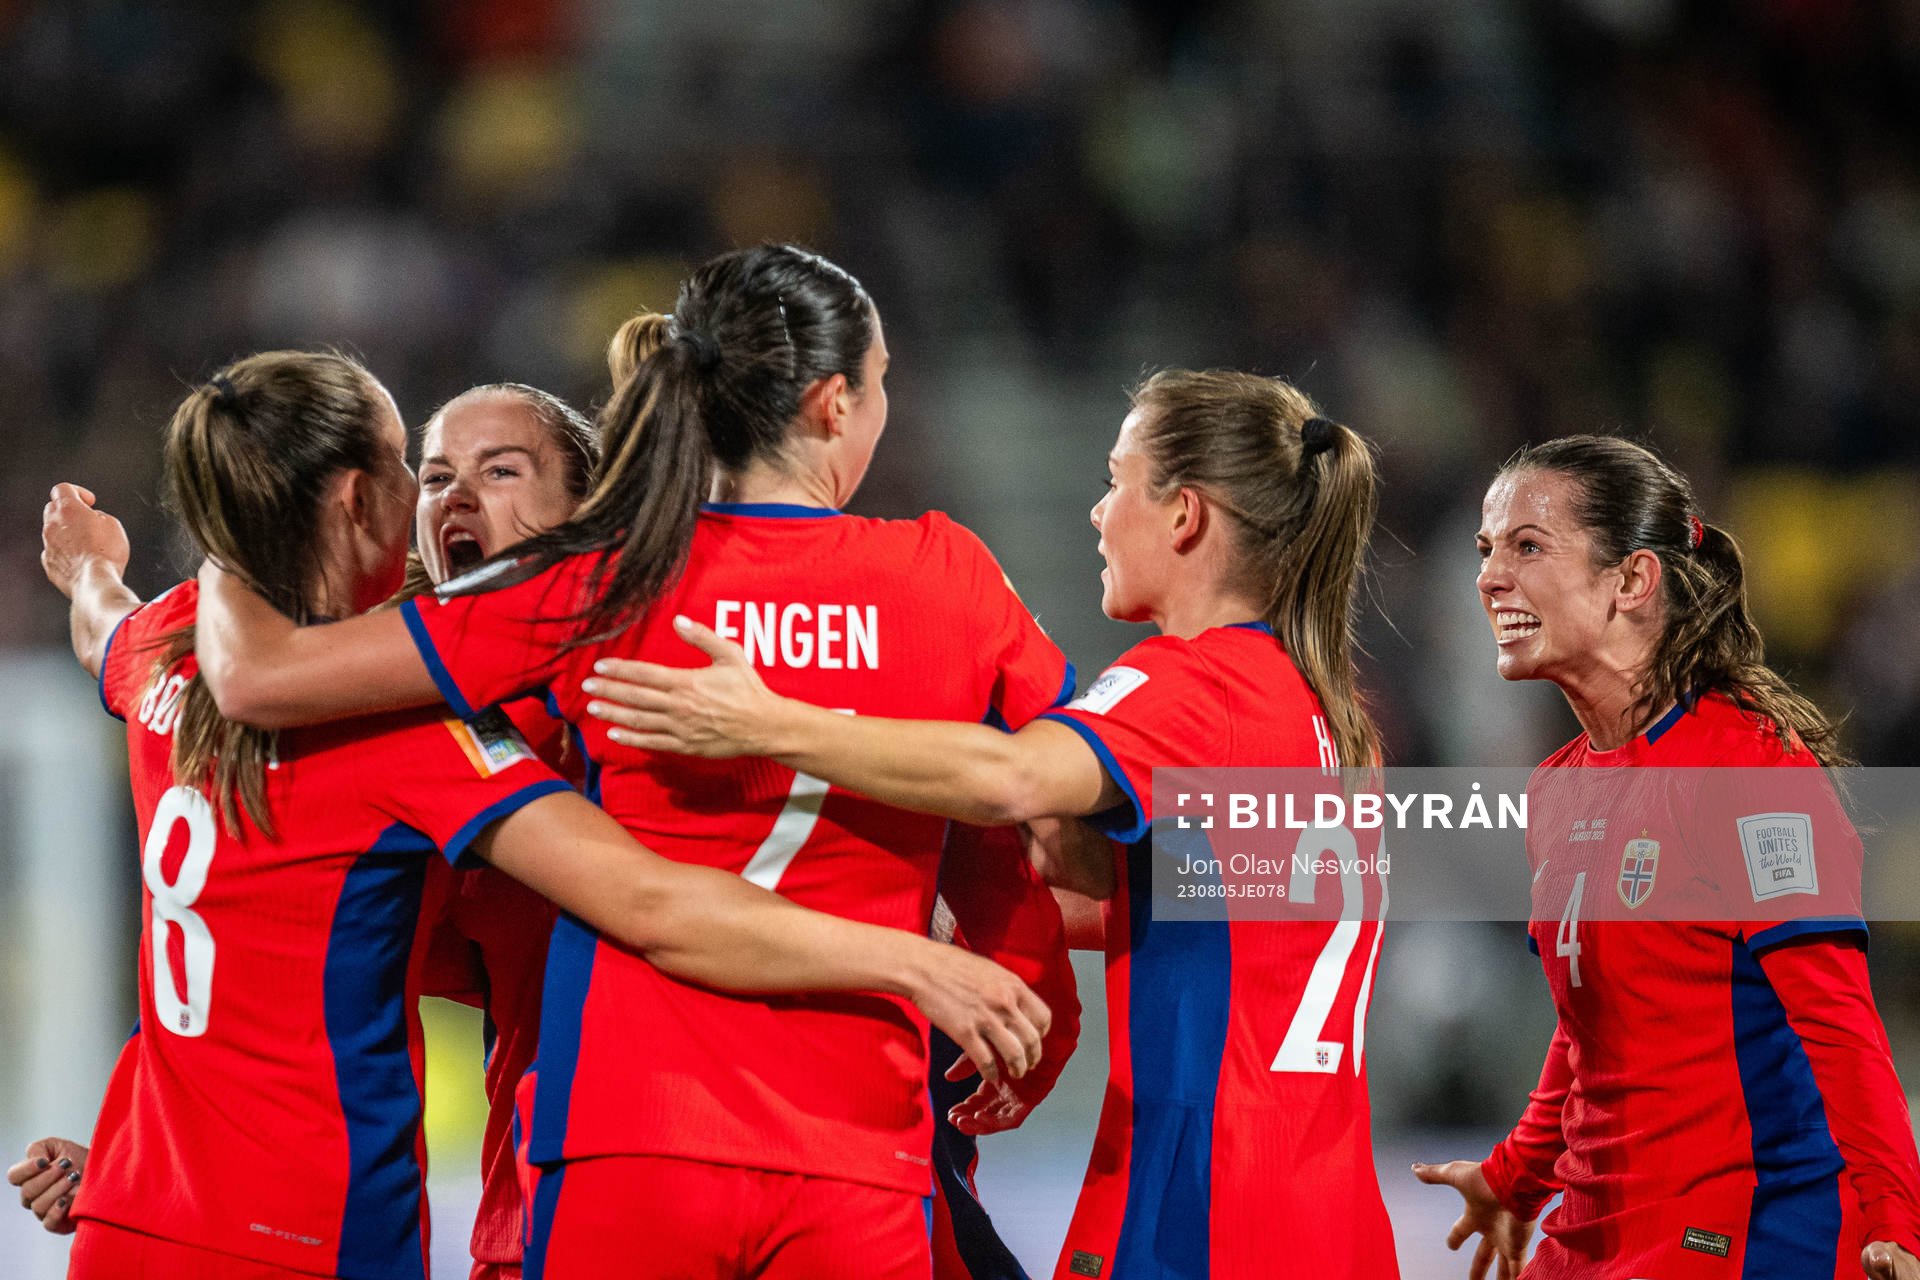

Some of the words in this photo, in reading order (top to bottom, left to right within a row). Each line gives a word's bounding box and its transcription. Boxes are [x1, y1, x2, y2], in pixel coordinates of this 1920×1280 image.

[714, 600, 879, 670] ENGEN
[1756, 827, 1797, 840] FOOTBALL
[1758, 838, 1799, 856] UNITES
[1759, 856, 1775, 869] the
[1775, 853, 1802, 866] World
[1774, 868, 1793, 880] FIFA
[142, 785, 216, 1037] 8
[1556, 871, 1587, 988] 4
